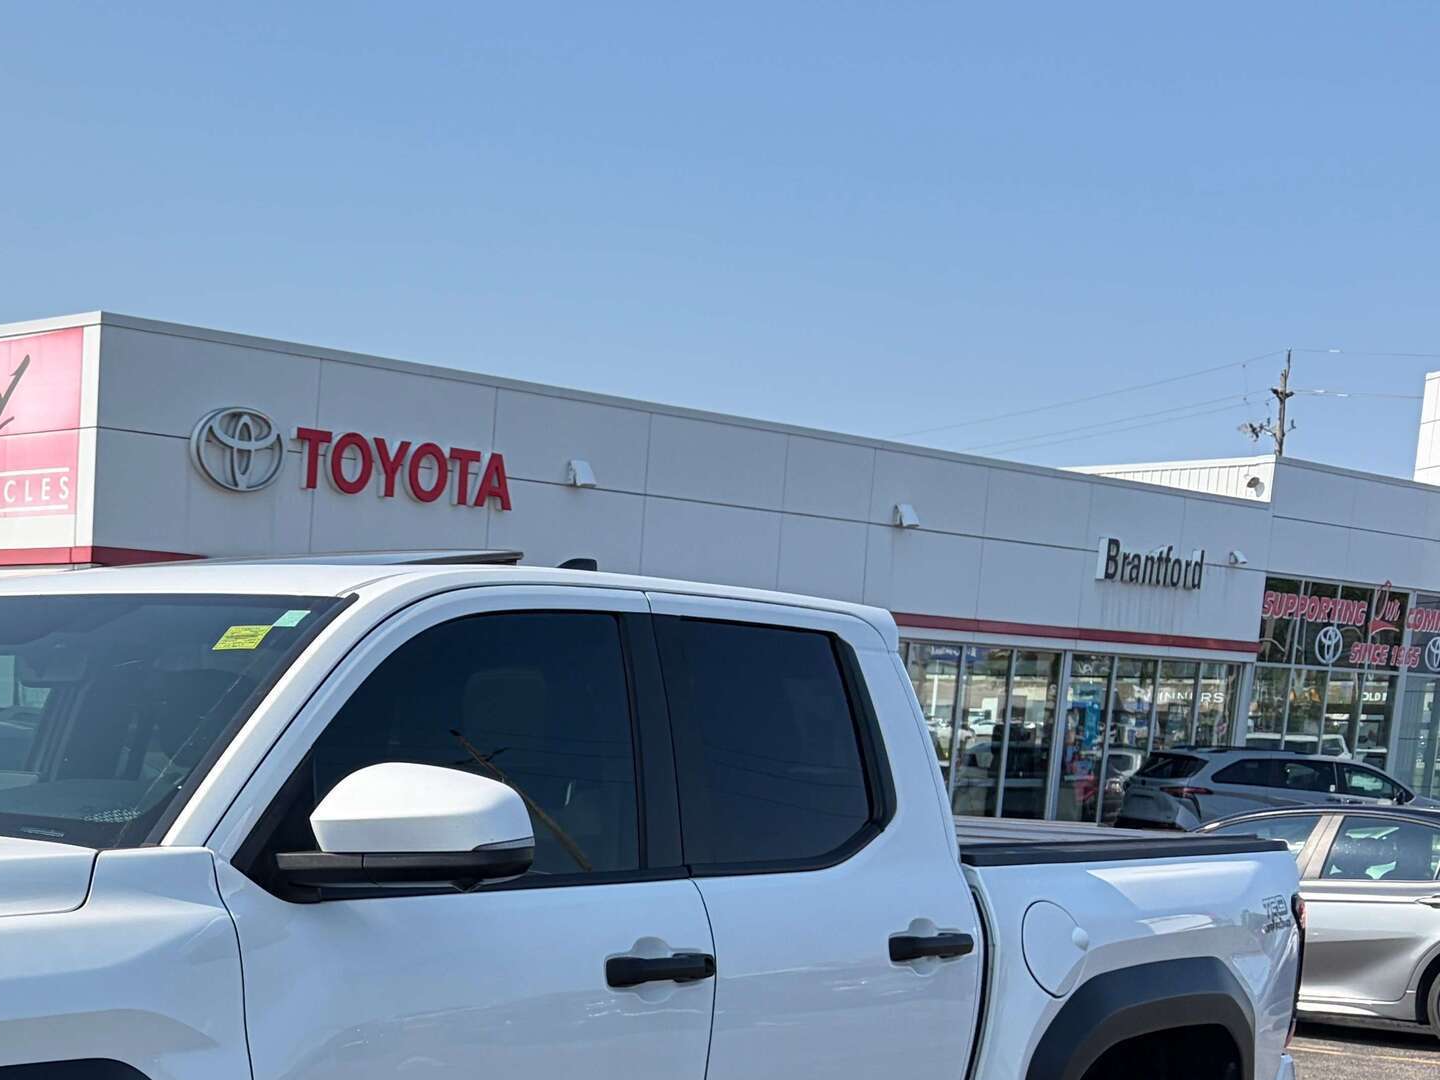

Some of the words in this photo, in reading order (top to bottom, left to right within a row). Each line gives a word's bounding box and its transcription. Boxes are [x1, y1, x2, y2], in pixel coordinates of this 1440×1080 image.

[295, 426, 512, 512] TOYOTA
[1103, 537, 1205, 590] Brantford
[1262, 590, 1368, 627] SUPPORTING
[1349, 641, 1389, 666] SINCE
